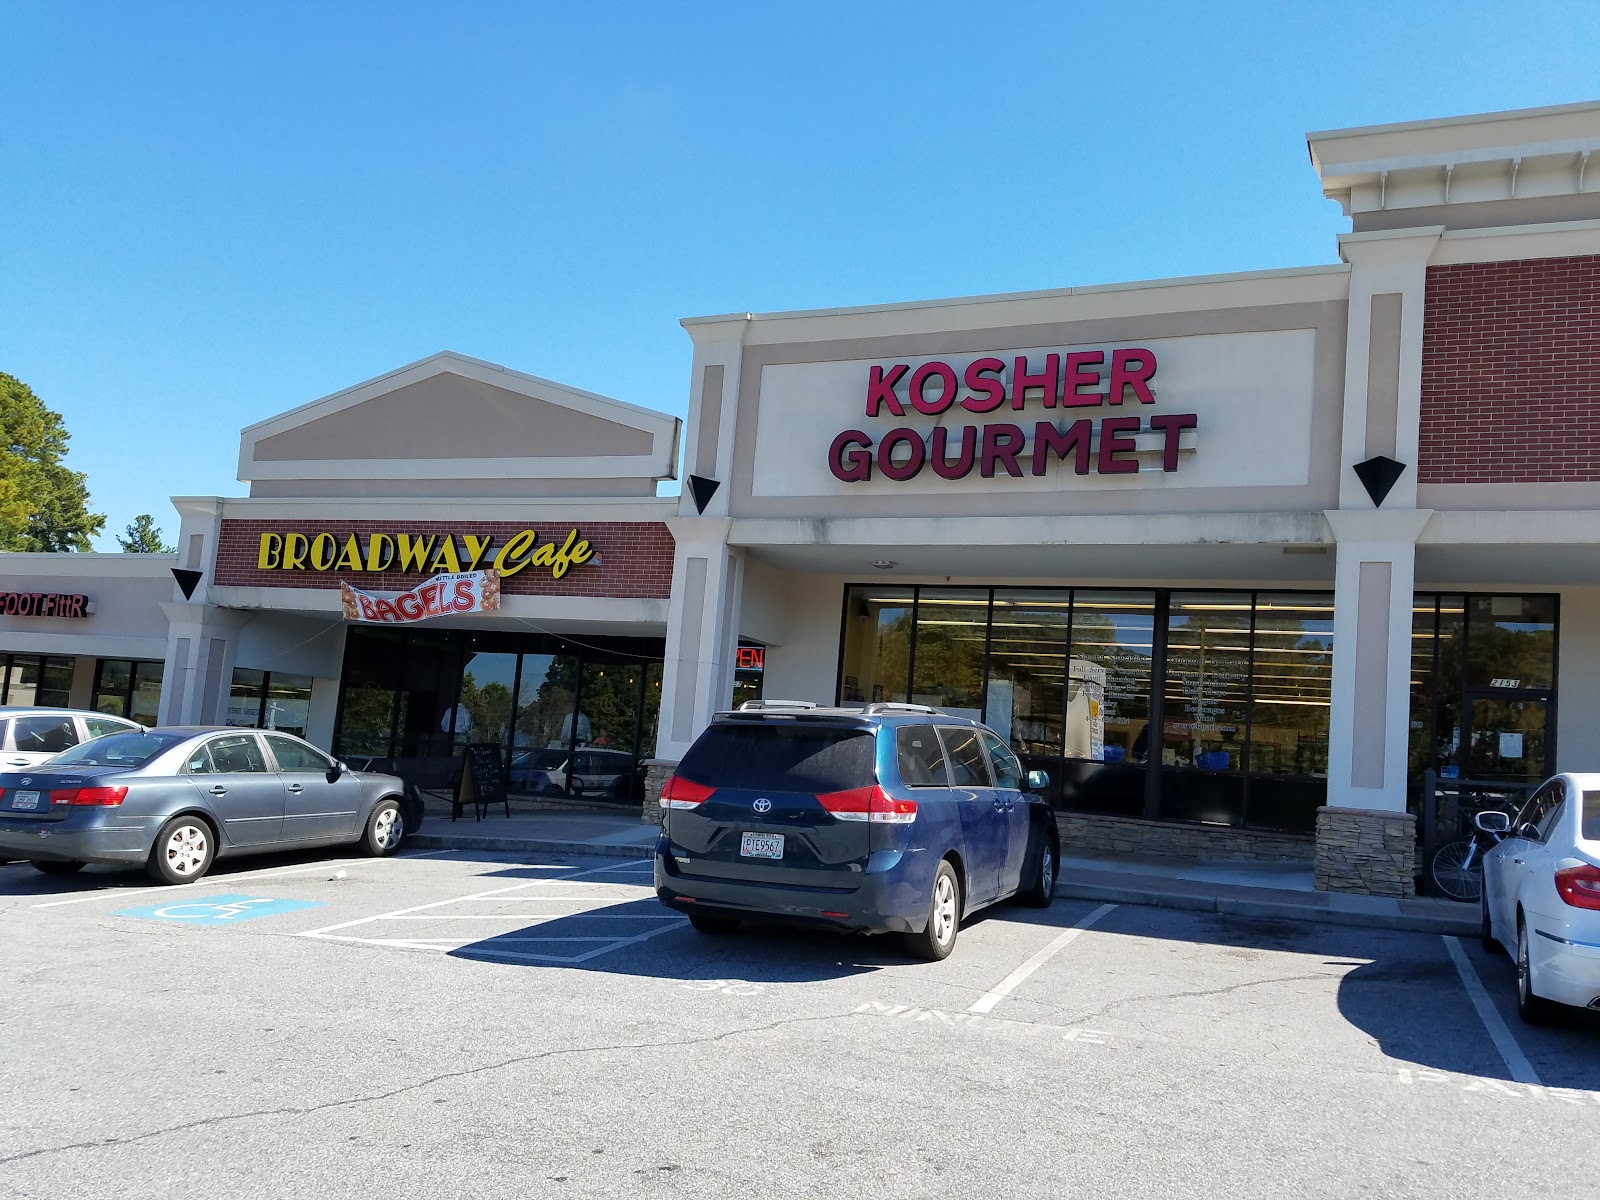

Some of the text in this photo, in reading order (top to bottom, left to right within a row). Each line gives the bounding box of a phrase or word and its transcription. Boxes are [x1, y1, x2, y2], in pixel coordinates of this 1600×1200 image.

[866, 348, 1157, 417] KOSHER
[828, 413, 1198, 482] GOURMET
[258, 528, 593, 580] BROADWAY Cafe
[358, 579, 476, 623] BAGELS
[1491, 679, 1519, 688] 2153
[746, 838, 780, 852] PTE9567
